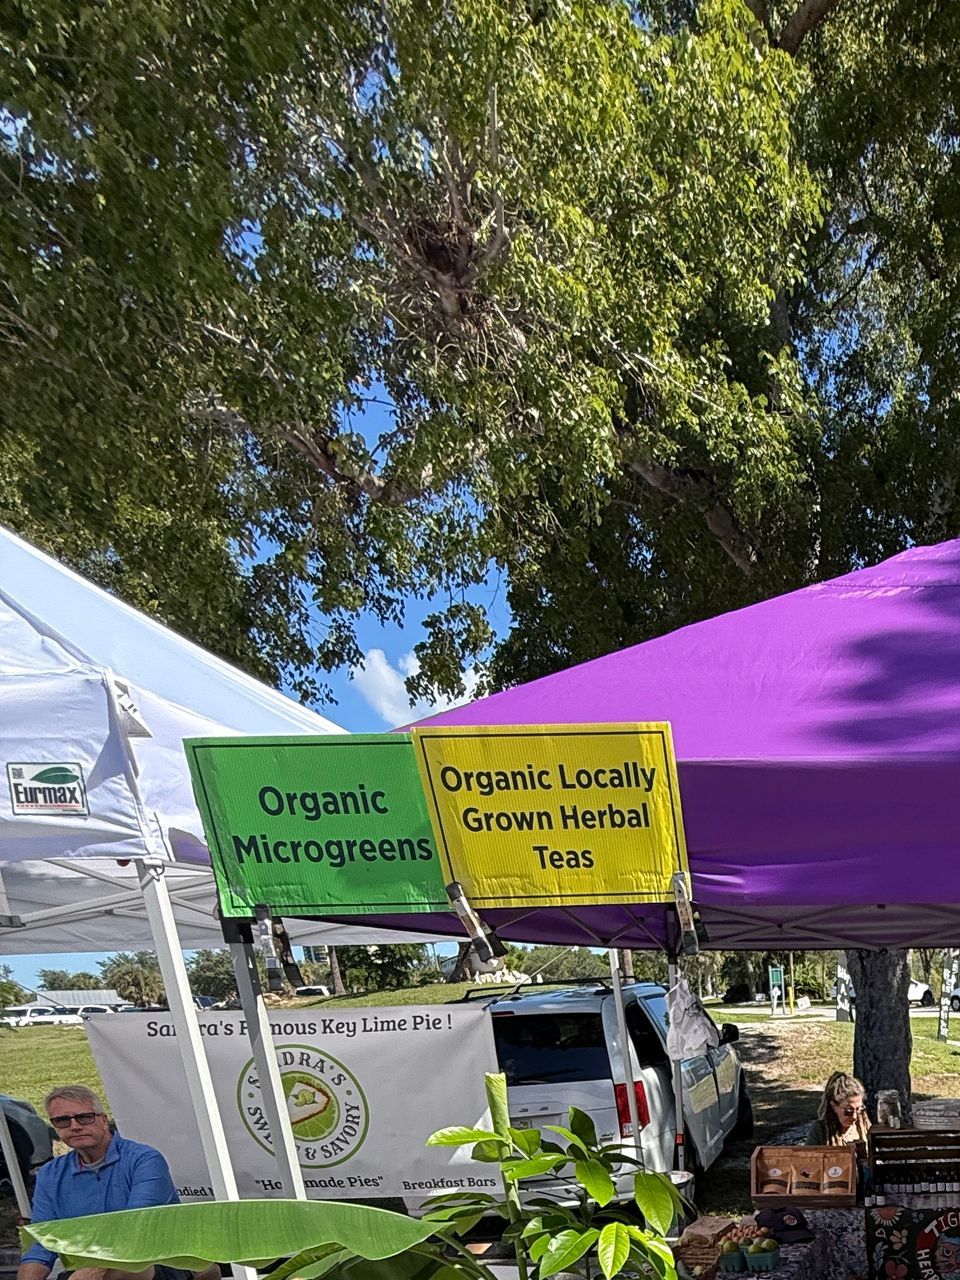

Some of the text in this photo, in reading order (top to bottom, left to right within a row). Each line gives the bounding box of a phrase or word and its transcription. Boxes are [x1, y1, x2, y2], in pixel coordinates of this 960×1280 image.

[440, 762, 656, 796] Organic Locally
[13, 782, 80, 804] Eurmax
[258, 784, 389, 821] Organic
[462, 803, 650, 832] Grown Herbal
[231, 834, 433, 868] Microgreens
[532, 845, 595, 870] Teas
[146, 1020, 234, 1037] Sara's
[239, 1020, 317, 1036] Fmous
[321, 1018, 357, 1038] Key
[361, 1016, 408, 1033] Lime
[411, 1013, 443, 1031] Pie
[304, 1146, 317, 1161] &
[320, 1101, 361, 1160] SAVORY
[348, 1175, 384, 1189] Pies"
[402, 1176, 497, 1191] Breakfast Bars
